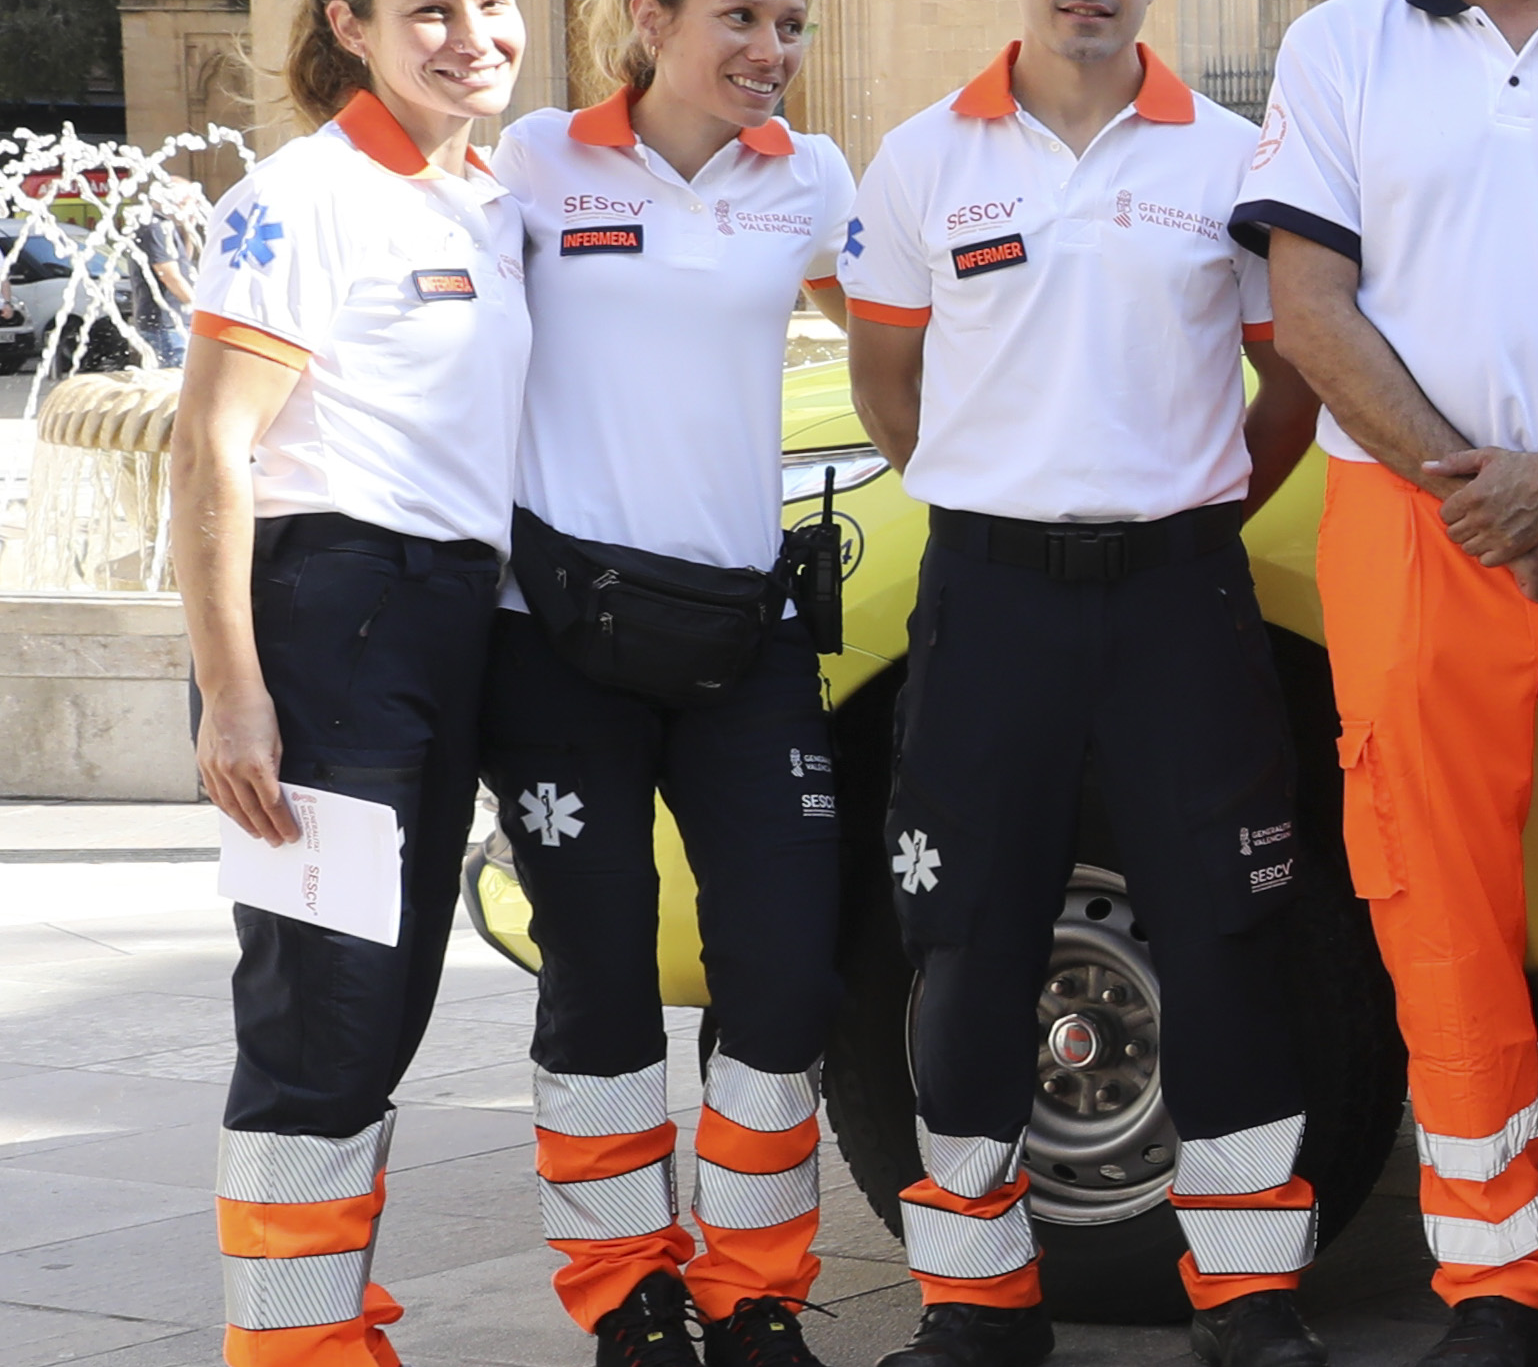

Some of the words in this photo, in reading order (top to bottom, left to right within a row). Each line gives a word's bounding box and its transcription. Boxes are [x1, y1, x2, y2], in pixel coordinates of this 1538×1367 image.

[564, 195, 645, 216] SESCV
[736, 212, 813, 225] GENERALITAT
[947, 202, 1016, 230] SESCV
[1138, 202, 1224, 231] GENERALITAT
[564, 232, 637, 248] INFERMERA
[738, 223, 812, 236] VALENCIANA
[1138, 212, 1220, 242] VALENCIANA
[957, 242, 1024, 270] INFERMER
[1250, 860, 1290, 884] SESCV
[306, 864, 320, 912] SESCV
